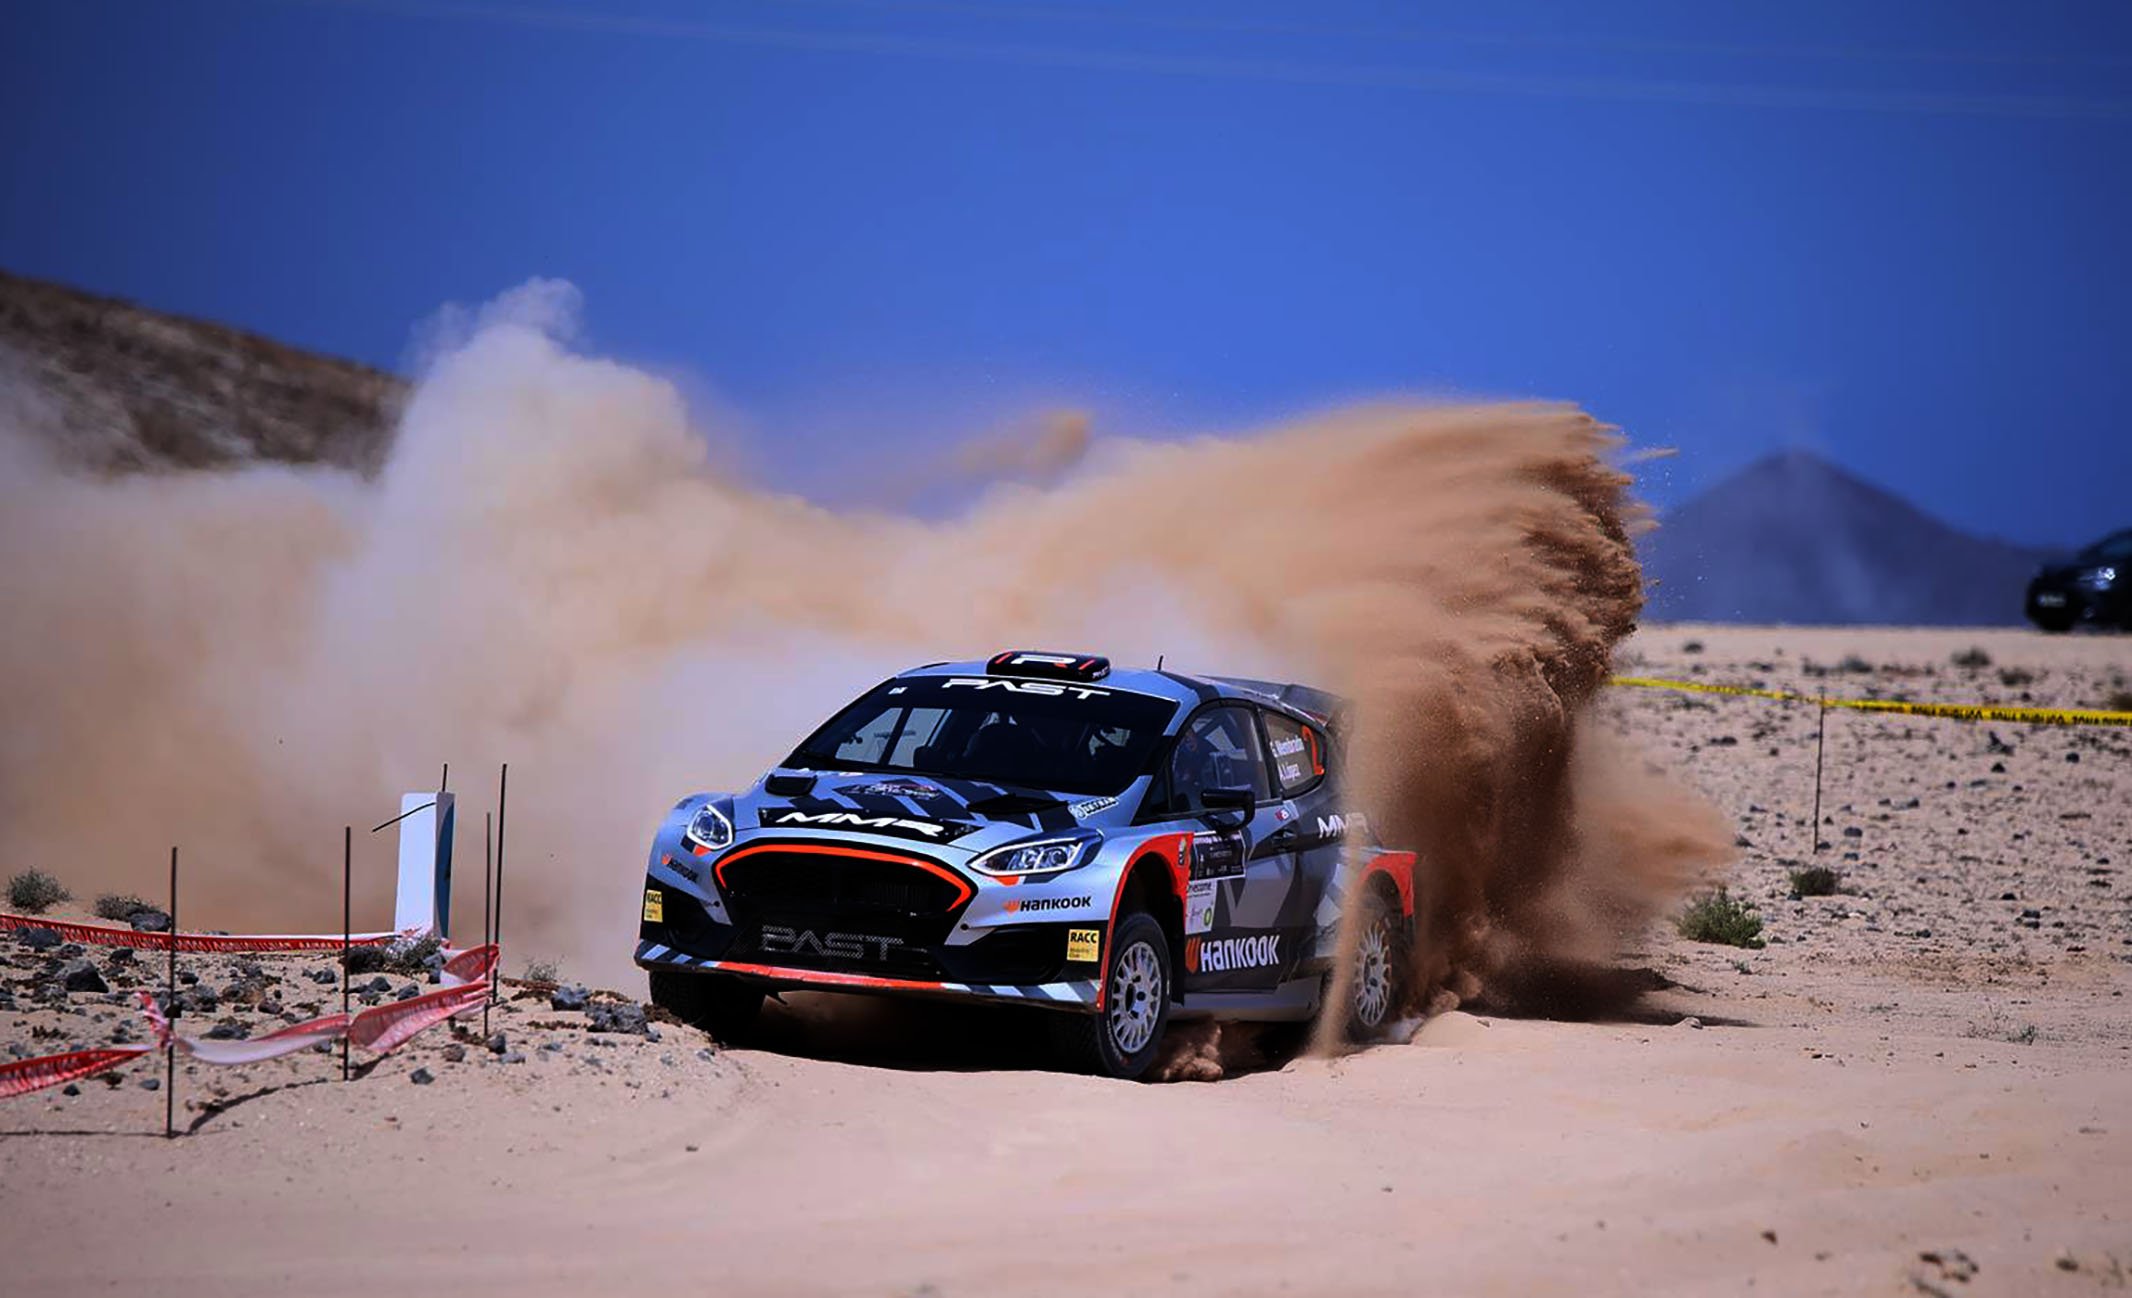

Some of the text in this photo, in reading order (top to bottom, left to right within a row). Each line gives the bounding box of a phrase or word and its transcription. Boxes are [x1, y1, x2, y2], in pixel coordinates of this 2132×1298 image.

[942, 678, 1111, 700] PAST
[776, 811, 945, 838] MMR
[760, 925, 905, 962] PAST
[1069, 932, 1098, 944] RACC
